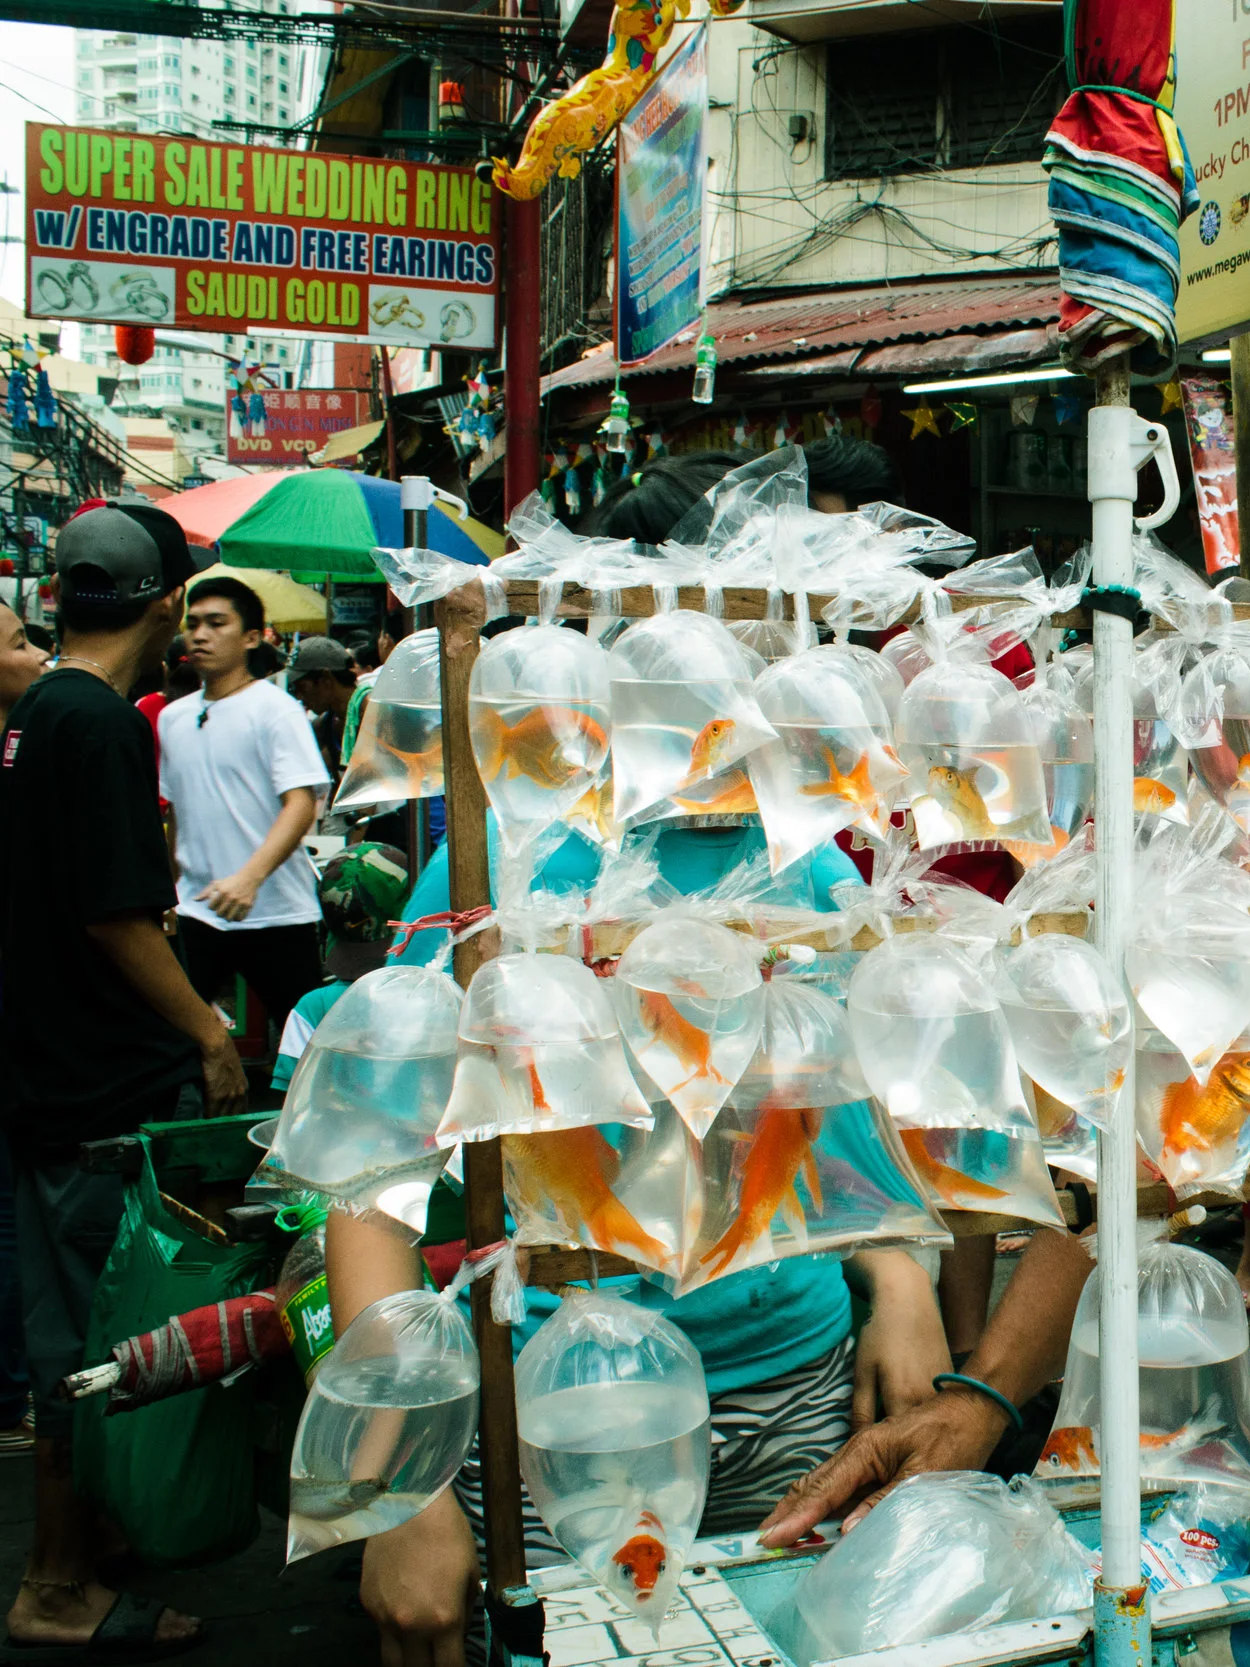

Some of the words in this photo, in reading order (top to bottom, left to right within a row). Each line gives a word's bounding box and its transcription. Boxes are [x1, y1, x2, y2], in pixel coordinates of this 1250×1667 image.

[39, 128, 157, 203] SUPER
[164, 142, 245, 212] SALE
[252, 151, 408, 228] WEDDING
[415, 168, 492, 235] RING
[1194, 153, 1227, 184] ucky
[87, 207, 229, 262] ENGRADE
[232, 220, 298, 267] AND
[301, 227, 370, 275] FREE
[372, 234, 496, 286] EARINGS
[186, 269, 279, 321] SAUDI
[285, 278, 361, 327] GOLD
[237, 439, 272, 452] DVD
[282, 439, 317, 452] VCD
[1183, 1531, 1200, 1542] 100
[1200, 1535, 1219, 1548] pcs.
